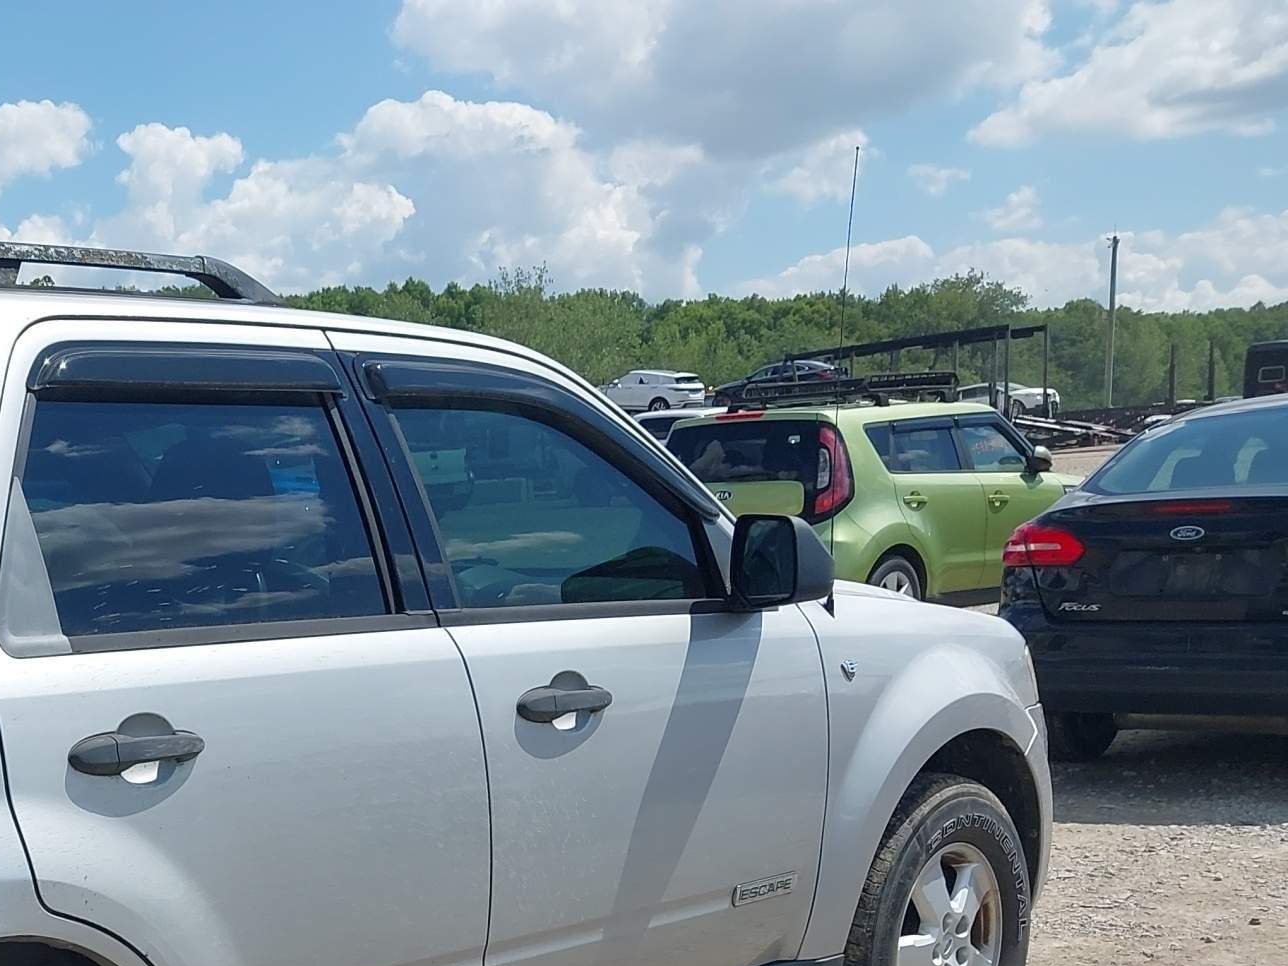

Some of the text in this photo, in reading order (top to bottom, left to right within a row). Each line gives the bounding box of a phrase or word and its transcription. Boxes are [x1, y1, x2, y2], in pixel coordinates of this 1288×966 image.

[715, 491, 730, 500] KIA
[740, 878, 793, 901] ESCAPE
[927, 813, 1029, 943] CONTINENTAL
